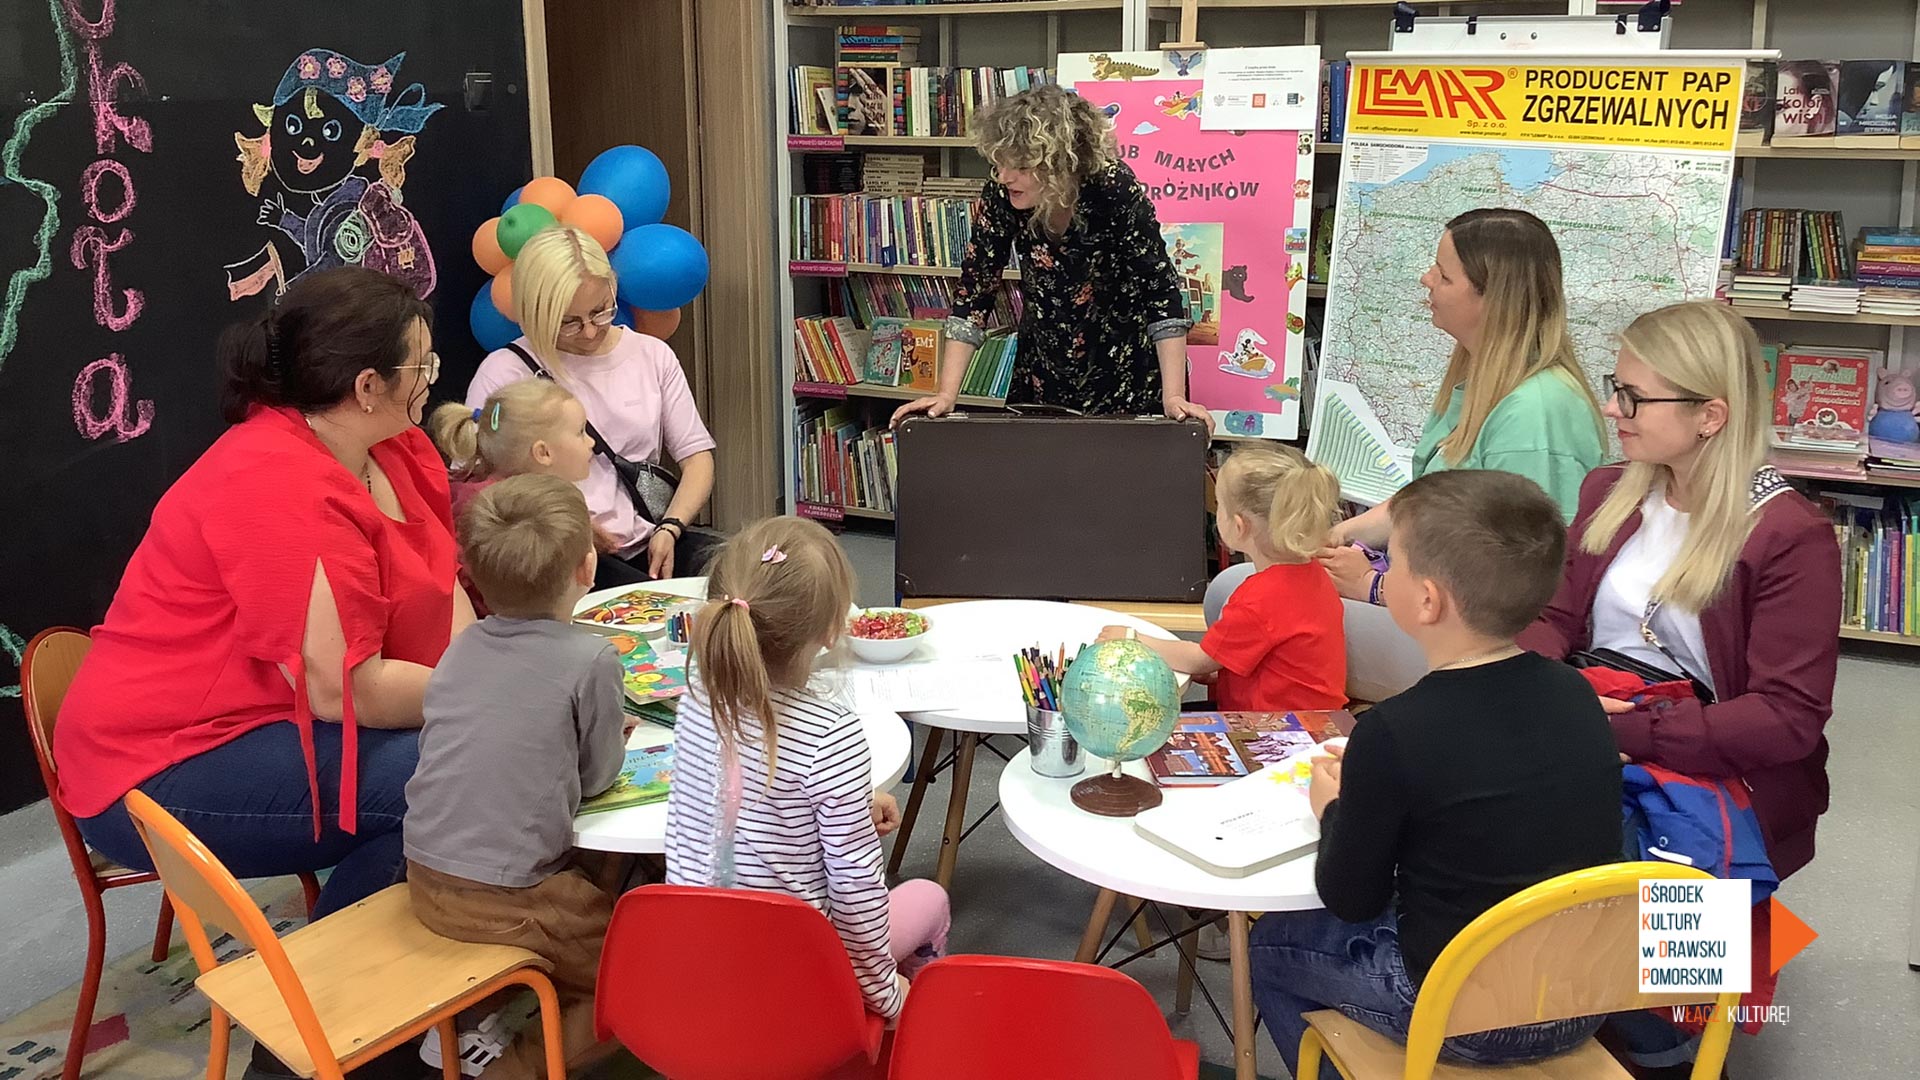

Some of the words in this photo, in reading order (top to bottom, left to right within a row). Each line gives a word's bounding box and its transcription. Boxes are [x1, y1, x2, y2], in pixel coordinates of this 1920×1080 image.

[1525, 69, 1669, 91] PRODUCENT
[1682, 71, 1731, 92] PAP
[1357, 68, 1507, 120] LEMAR
[1466, 119, 1481, 128] Sp.
[1522, 94, 1729, 130] ZGRZEWALNYCH
[1154, 148, 1236, 172] MAŁYCH
[1139, 177, 1260, 201] DRÓŻNIKÓW
